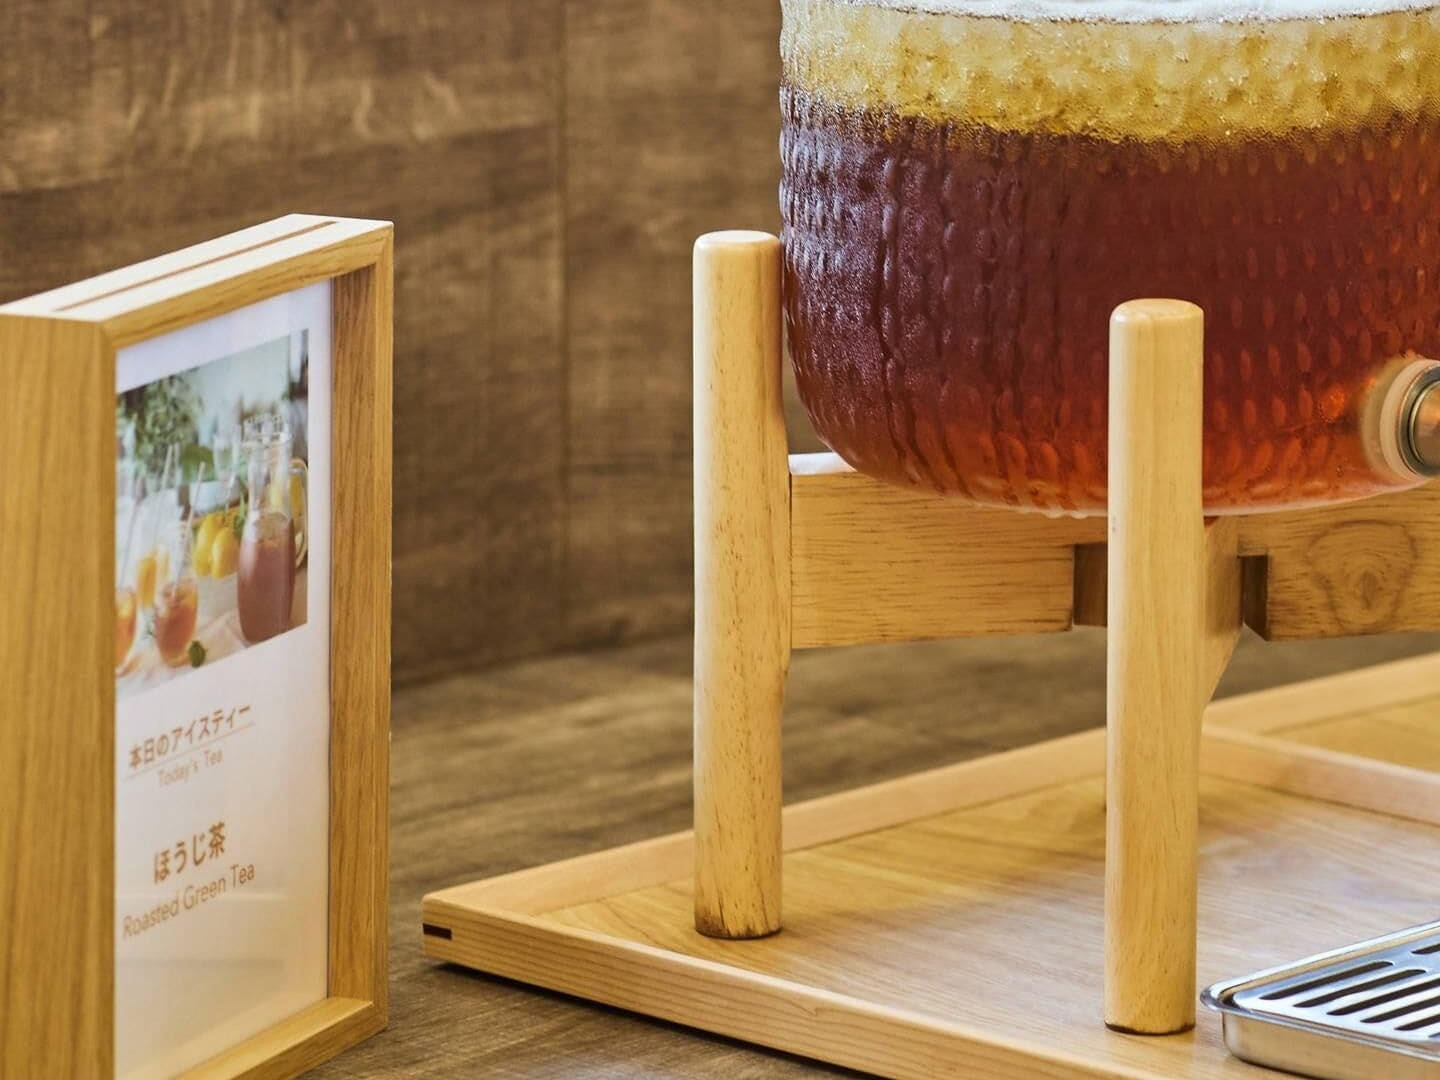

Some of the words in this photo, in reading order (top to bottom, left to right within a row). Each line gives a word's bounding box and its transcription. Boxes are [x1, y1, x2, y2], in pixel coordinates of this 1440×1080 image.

[128, 704, 252, 769] 本日のアイスティー
[156, 759, 199, 788] Today's
[203, 748, 224, 766] Tea
[153, 821, 227, 884] ほうじ茶
[122, 895, 180, 939] Roasted
[182, 875, 227, 910] Green
[229, 863, 256, 889] Tea
